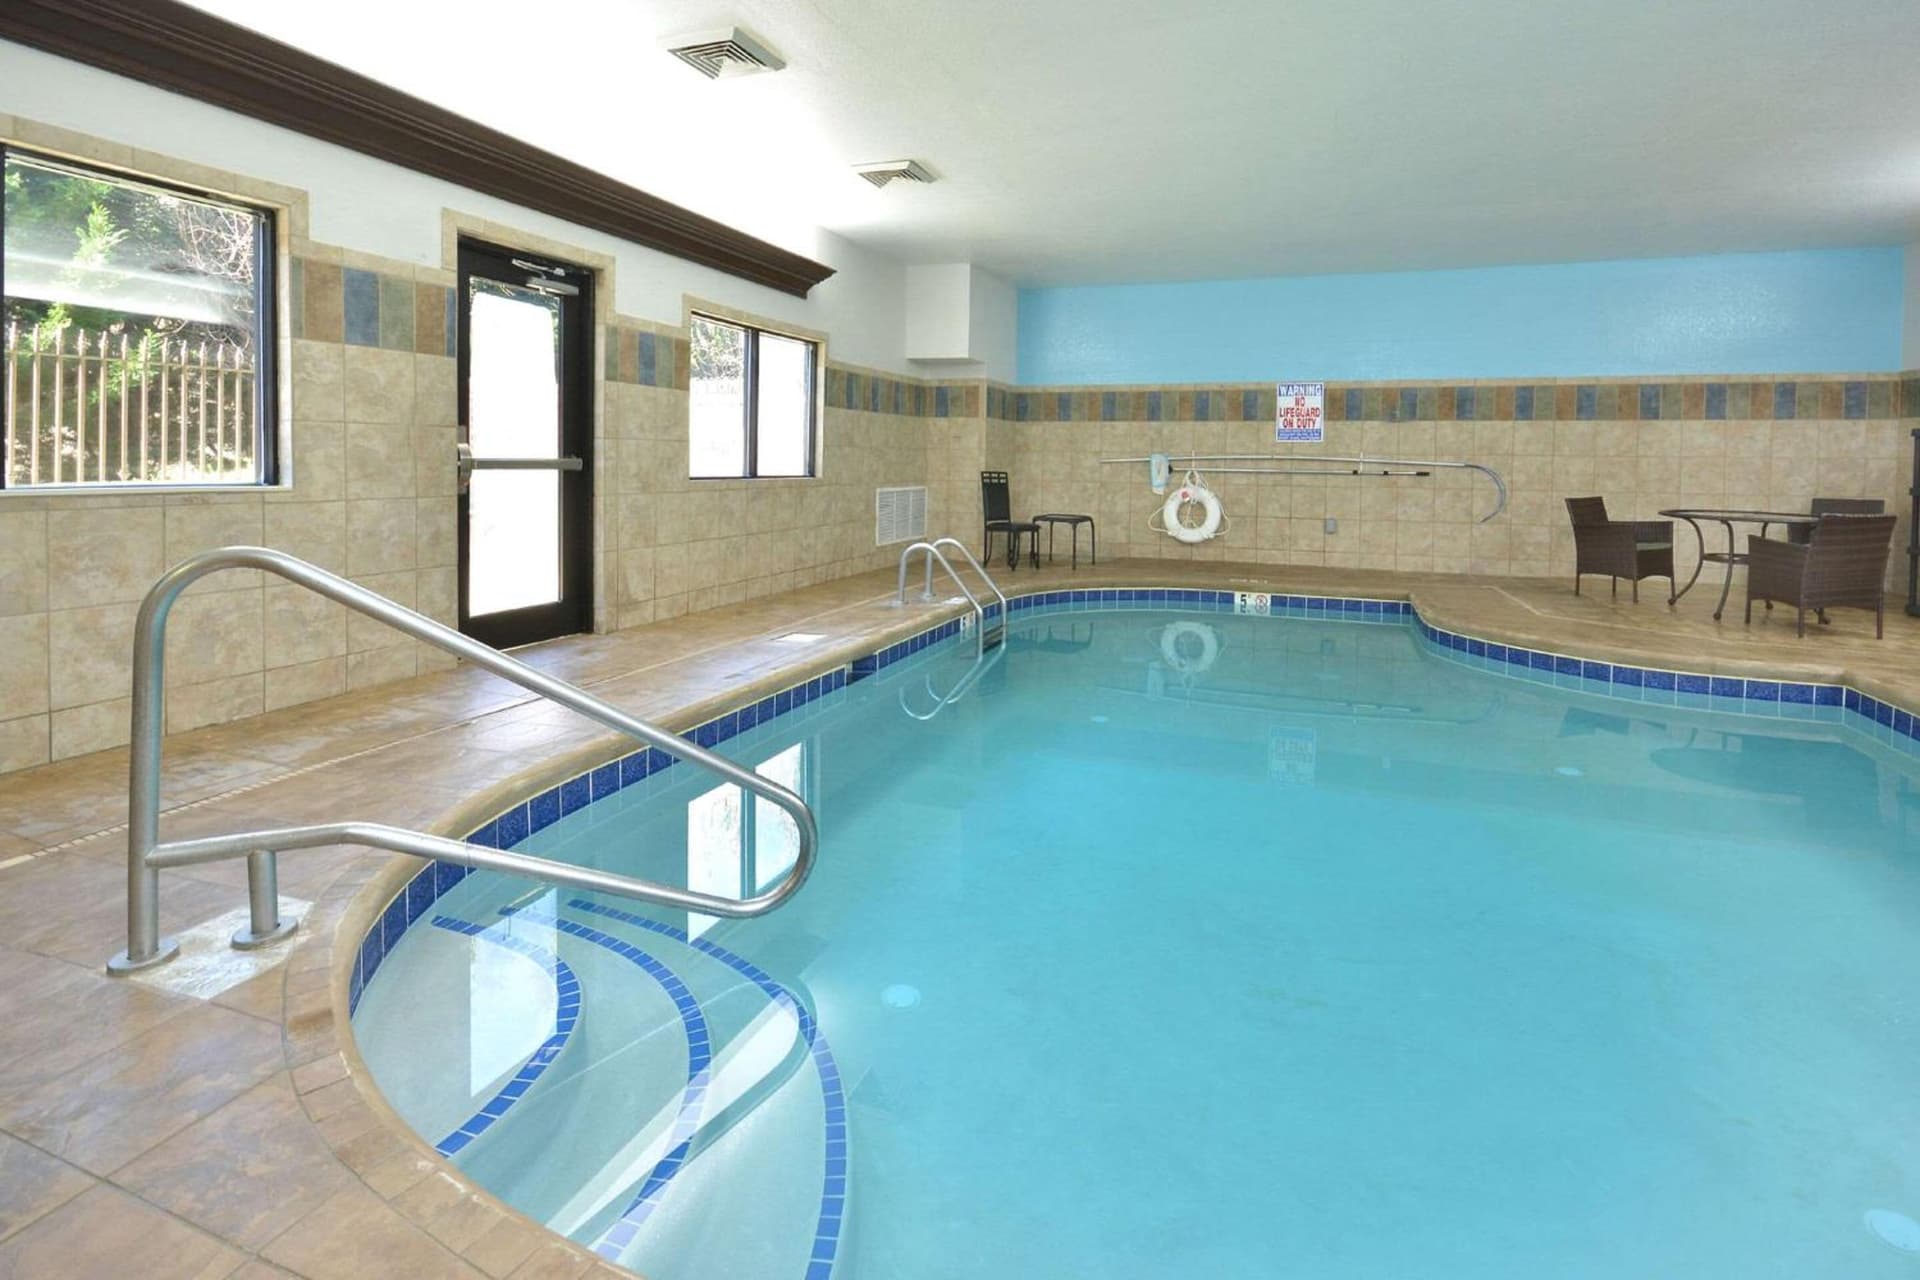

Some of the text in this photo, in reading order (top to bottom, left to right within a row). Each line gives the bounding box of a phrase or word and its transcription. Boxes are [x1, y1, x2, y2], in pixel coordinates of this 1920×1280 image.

[1279, 384, 1322, 397] WARNING
[1295, 397, 1305, 407] NO
[1279, 408, 1320, 418] LIFEGUARD
[1283, 418, 1316, 428] ON DUTY
